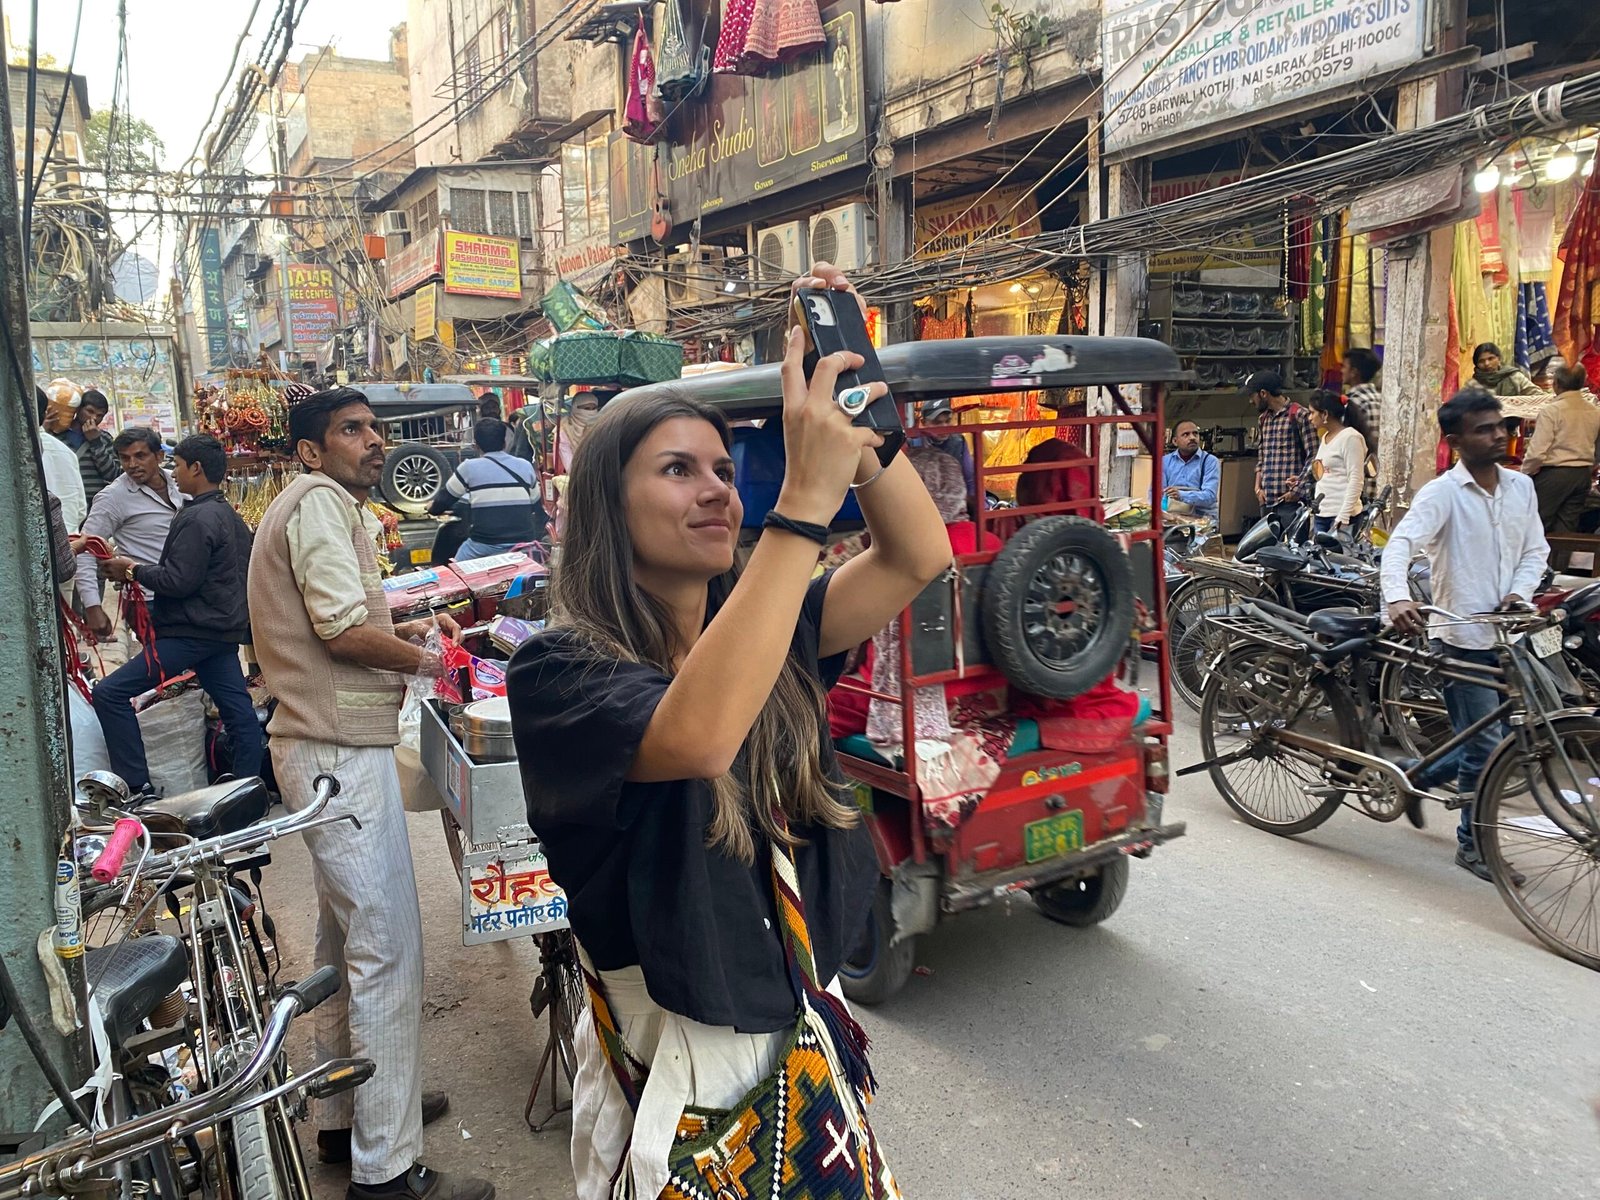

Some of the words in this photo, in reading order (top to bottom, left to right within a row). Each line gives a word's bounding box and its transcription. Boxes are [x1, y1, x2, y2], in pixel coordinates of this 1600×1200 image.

[1239, 24, 1250, 43] &
[1256, 0, 1334, 36] RETAILER
[1178, 59, 1210, 88] FANCY
[1300, 7, 1361, 47] WEDDING
[1242, 69, 1263, 87] NAI
[1266, 53, 1308, 79] SARAK
[668, 129, 706, 181] Sneha
[711, 107, 754, 163] Studio
[810, 152, 848, 172] Sherwani
[928, 203, 999, 237] SHARMA
[455, 240, 511, 259] SHARMA
[922, 233, 969, 255] FASHION
[450, 252, 487, 266] FASHION
[488, 257, 517, 269] HOUSE
[306, 289, 334, 299] CENTER
